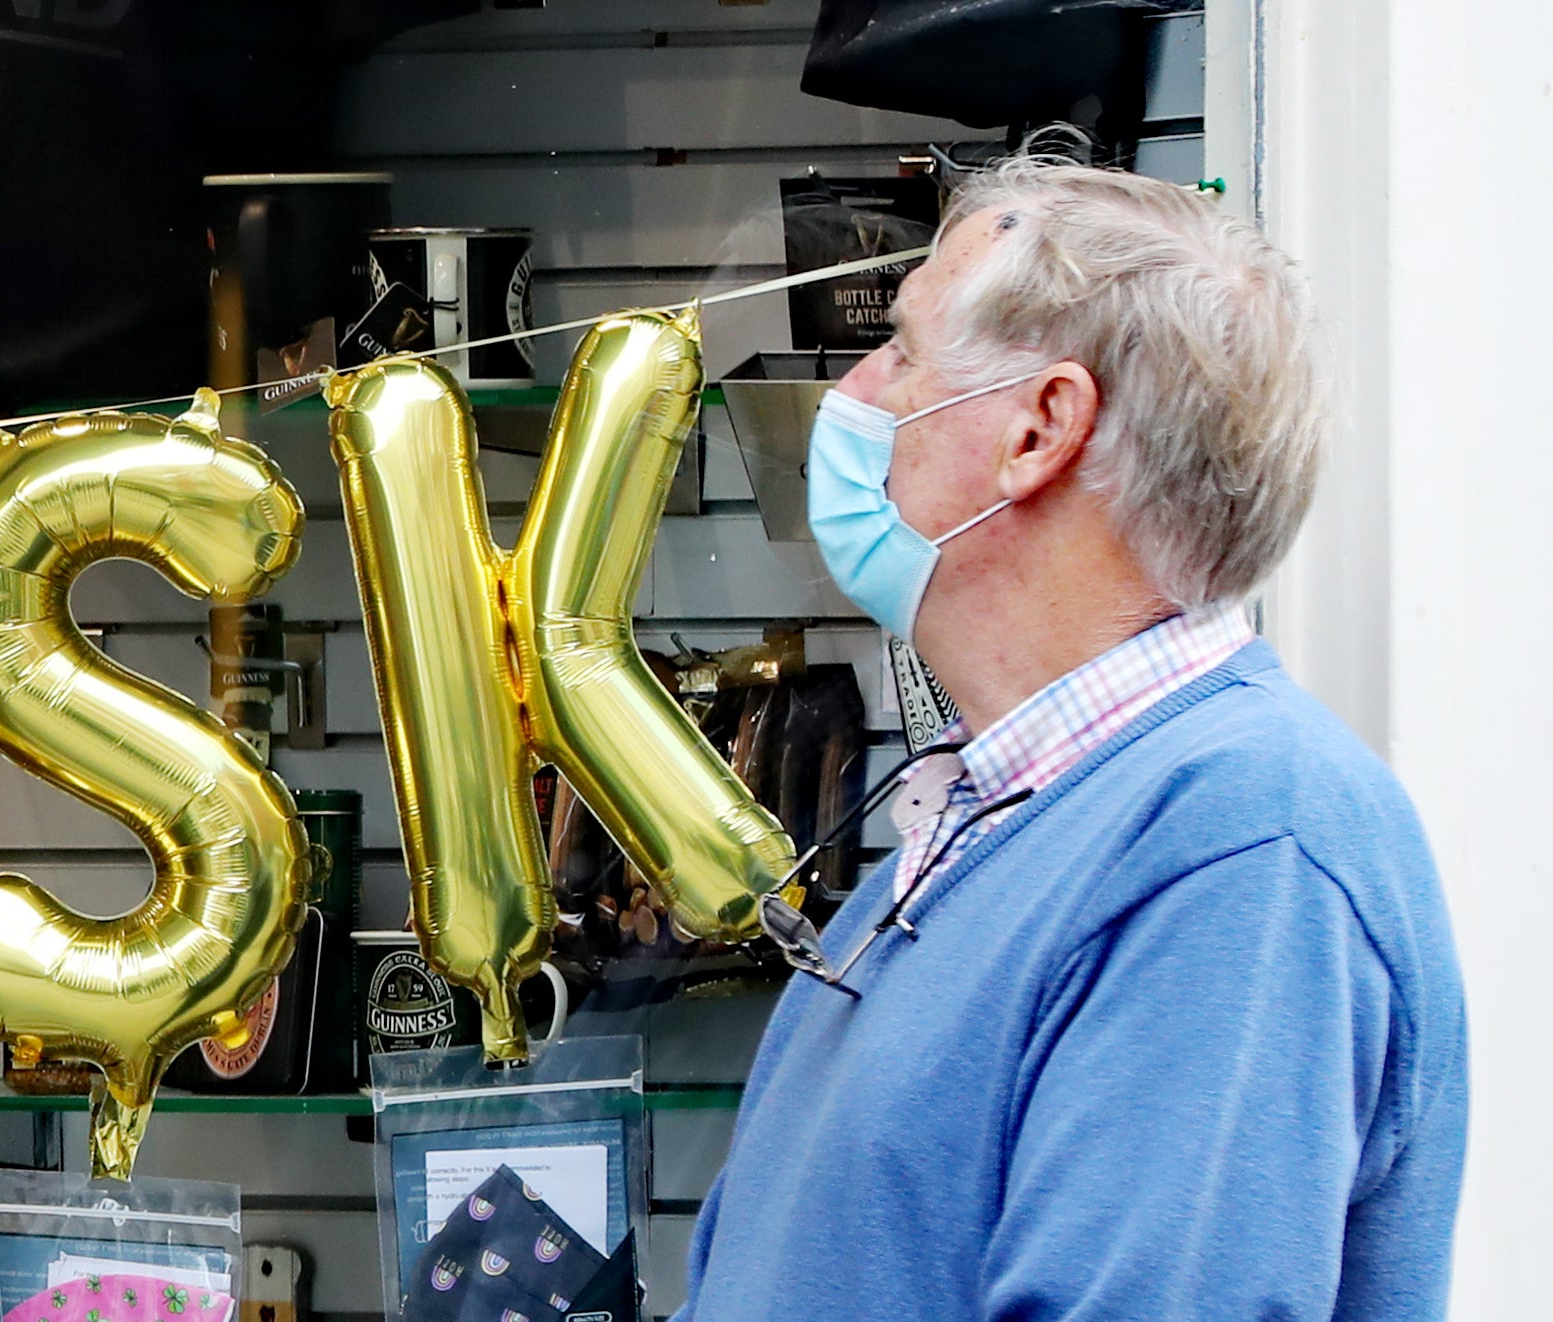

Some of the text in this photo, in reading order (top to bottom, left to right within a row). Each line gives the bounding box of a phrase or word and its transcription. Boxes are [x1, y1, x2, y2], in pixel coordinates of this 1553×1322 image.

[834, 290, 882, 307] BOTTLE
[846, 307, 890, 325] CATCH
[222, 672, 270, 685] GUINNESS
[370, 1007, 448, 1034] GUINNESS
